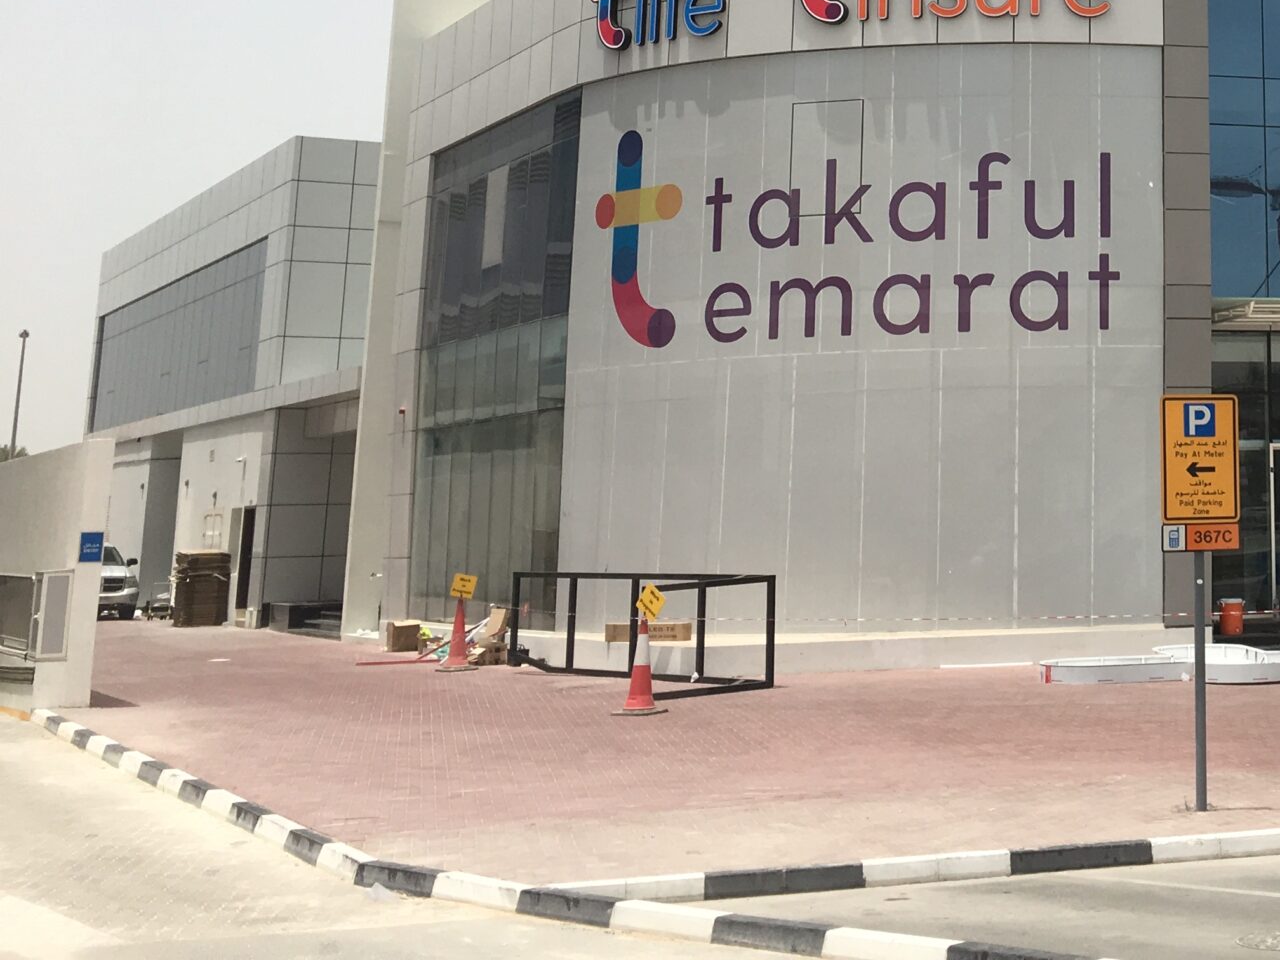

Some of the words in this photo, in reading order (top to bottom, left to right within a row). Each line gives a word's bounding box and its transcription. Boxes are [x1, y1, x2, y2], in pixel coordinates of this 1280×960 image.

[705, 152, 1111, 252] takaful
[704, 253, 1121, 343] emarat
[1188, 405, 1212, 436] P
[1175, 450, 1188, 459] Pay
[1191, 450, 1201, 458] At
[1203, 450, 1225, 458] Meter
[1179, 499, 1195, 507] Paid
[1197, 499, 1223, 508] Parking
[1193, 529, 1233, 544] 367C
